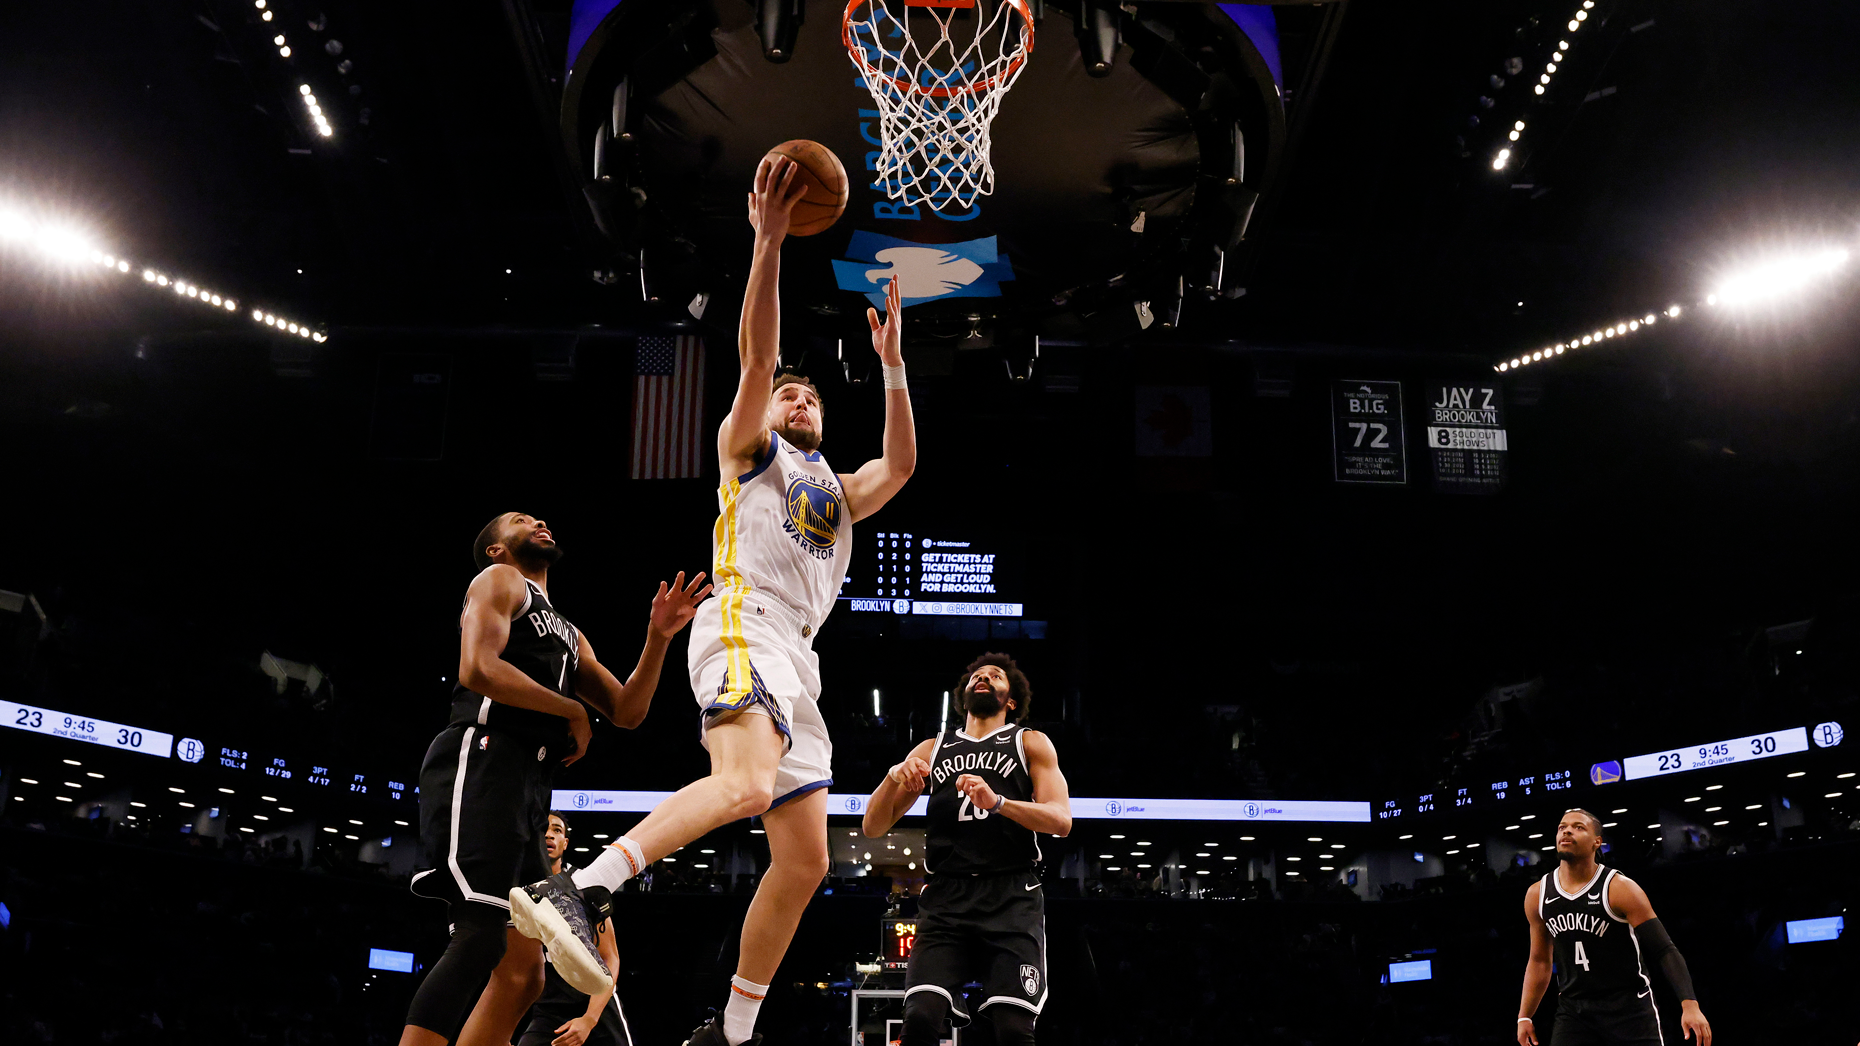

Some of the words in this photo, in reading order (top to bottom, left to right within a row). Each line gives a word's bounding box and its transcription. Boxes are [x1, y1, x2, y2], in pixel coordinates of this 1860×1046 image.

[1435, 387, 1474, 409] JAY
[1481, 388, 1495, 410] Z
[1349, 399, 1388, 414] B.I.G.
[1435, 410, 1496, 424] BROOKLYN
[1348, 422, 1390, 448] 72
[1437, 429, 1450, 445] 8
[1452, 430, 1475, 438] SOLD
[1478, 431, 1496, 440] OUT
[1452, 439, 1486, 447] SHOWS
[821, 479, 840, 496] STA
[826, 502, 834, 519] 11
[921, 553, 941, 562] GET
[942, 553, 981, 563] TICKETS
[981, 554, 996, 563] AT
[921, 563, 994, 573] TICKETMASTER
[920, 573, 942, 582] AND
[943, 574, 963, 582] GET
[963, 574, 991, 583] LOUD
[920, 583, 941, 592] FOR
[942, 583, 996, 593] BROOKLYN.
[851, 600, 890, 612] BROOKLYN
[946, 604, 1014, 615] @BROOKLYNNETS
[558, 651, 568, 691] 1
[15, 708, 43, 728] 23
[63, 717, 96, 733] 9:45
[117, 729, 142, 747] 30
[53, 728, 68, 737] 2nd
[70, 730, 99, 742] Quarter
[221, 747, 240, 758] FLS:
[1658, 753, 1682, 772] 23
[1698, 744, 1729, 759] 9:45
[1750, 737, 1776, 755] 30
[220, 757, 239, 768] TOL:
[274, 758, 285, 767] FG
[1708, 755, 1735, 766] Quarter
[312, 766, 328, 776] 3PT
[933, 752, 1017, 784] BROOKLYN
[354, 774, 364, 783] FT
[1519, 777, 1535, 786] AST
[1545, 772, 1563, 782] FLS:
[388, 781, 405, 791] REB
[1492, 782, 1508, 791] REB
[1546, 782, 1564, 791] TOL:
[1419, 794, 1433, 803] 3PT
[1496, 791, 1506, 799] 19
[958, 790, 989, 822] 2
[1545, 912, 1609, 938] BROOKLYN
[1575, 941, 1590, 971] 4
